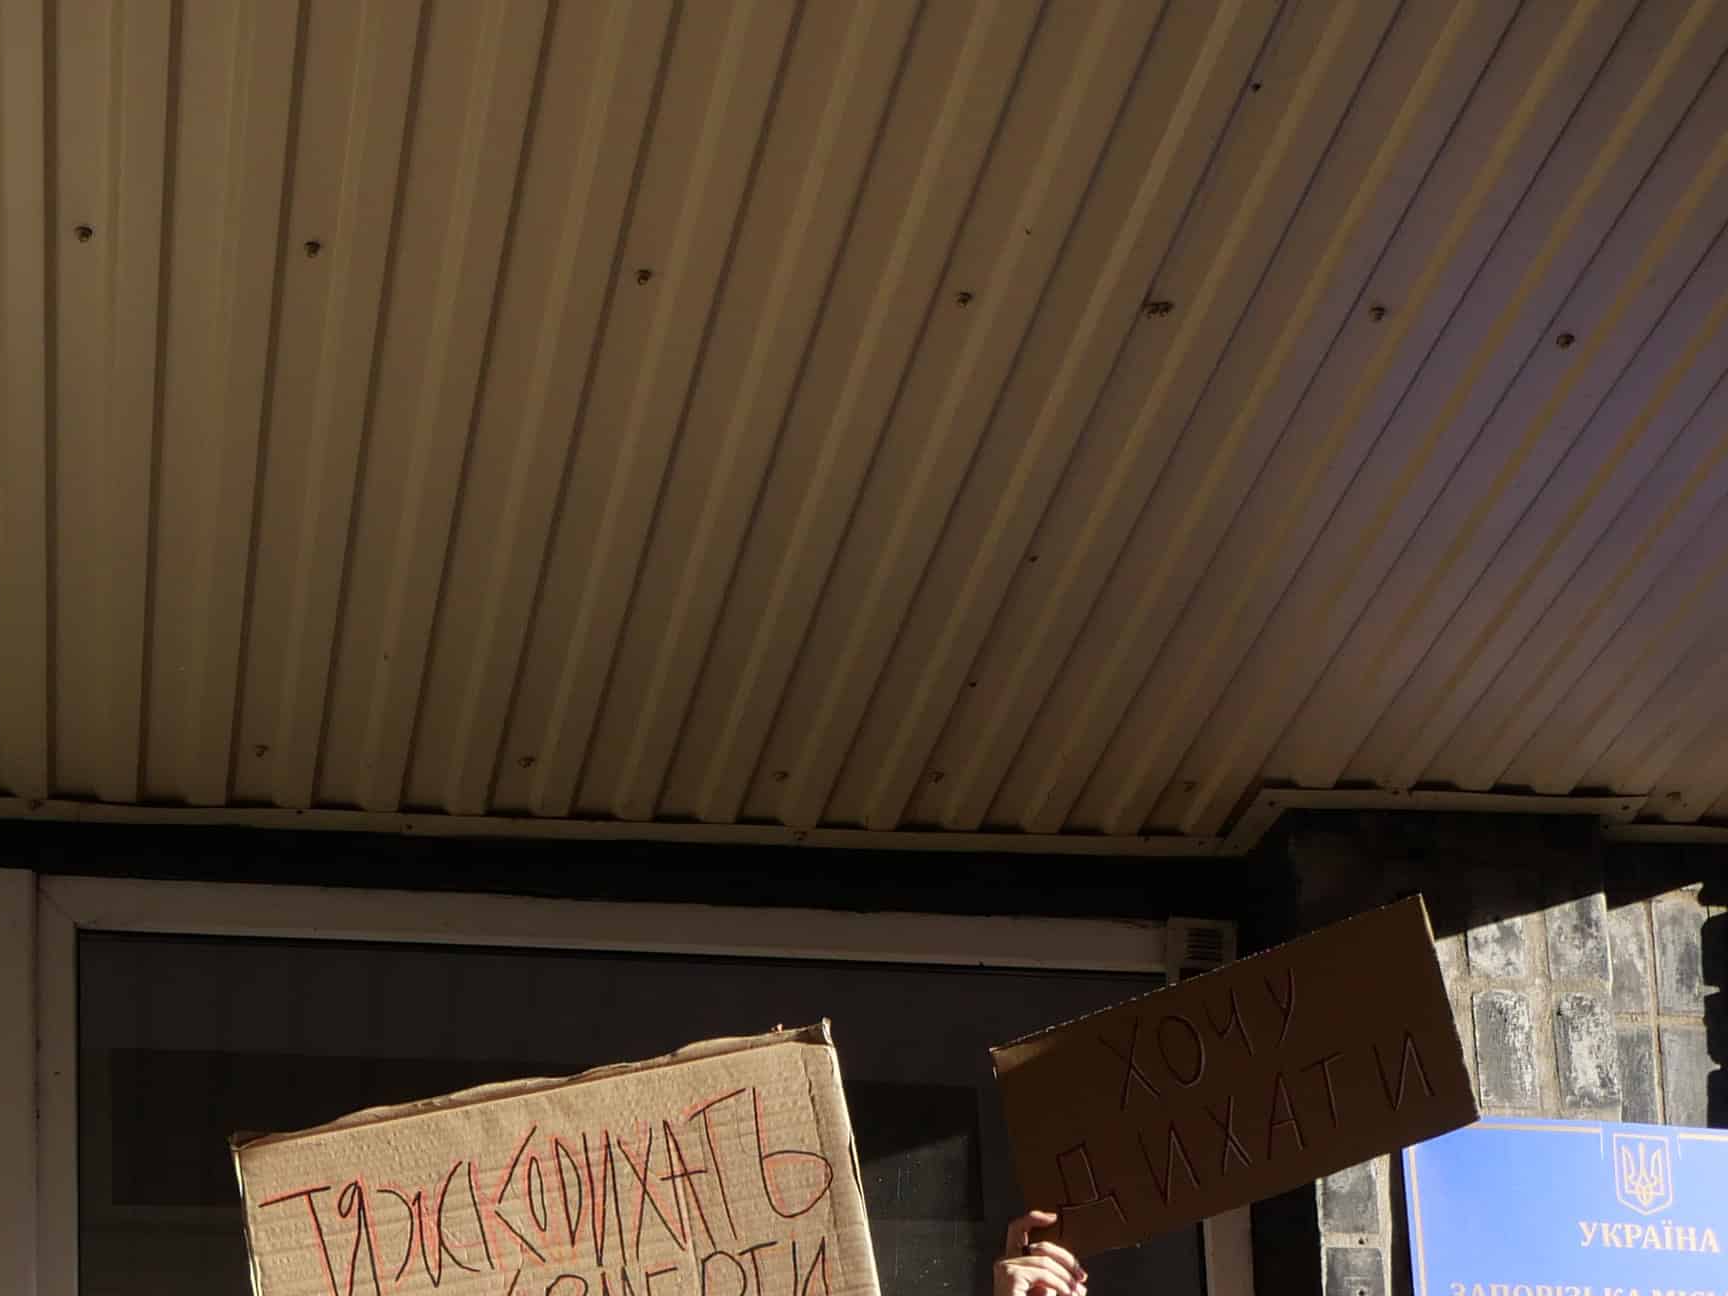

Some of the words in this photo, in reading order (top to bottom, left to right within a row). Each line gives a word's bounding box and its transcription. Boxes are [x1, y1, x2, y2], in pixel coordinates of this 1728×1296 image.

[1097, 968, 1296, 1111] ХОЧУ
[1056, 1030, 1436, 1239] ДИХАТИ
[1579, 1220, 1720, 1254] УКРАЇНА
